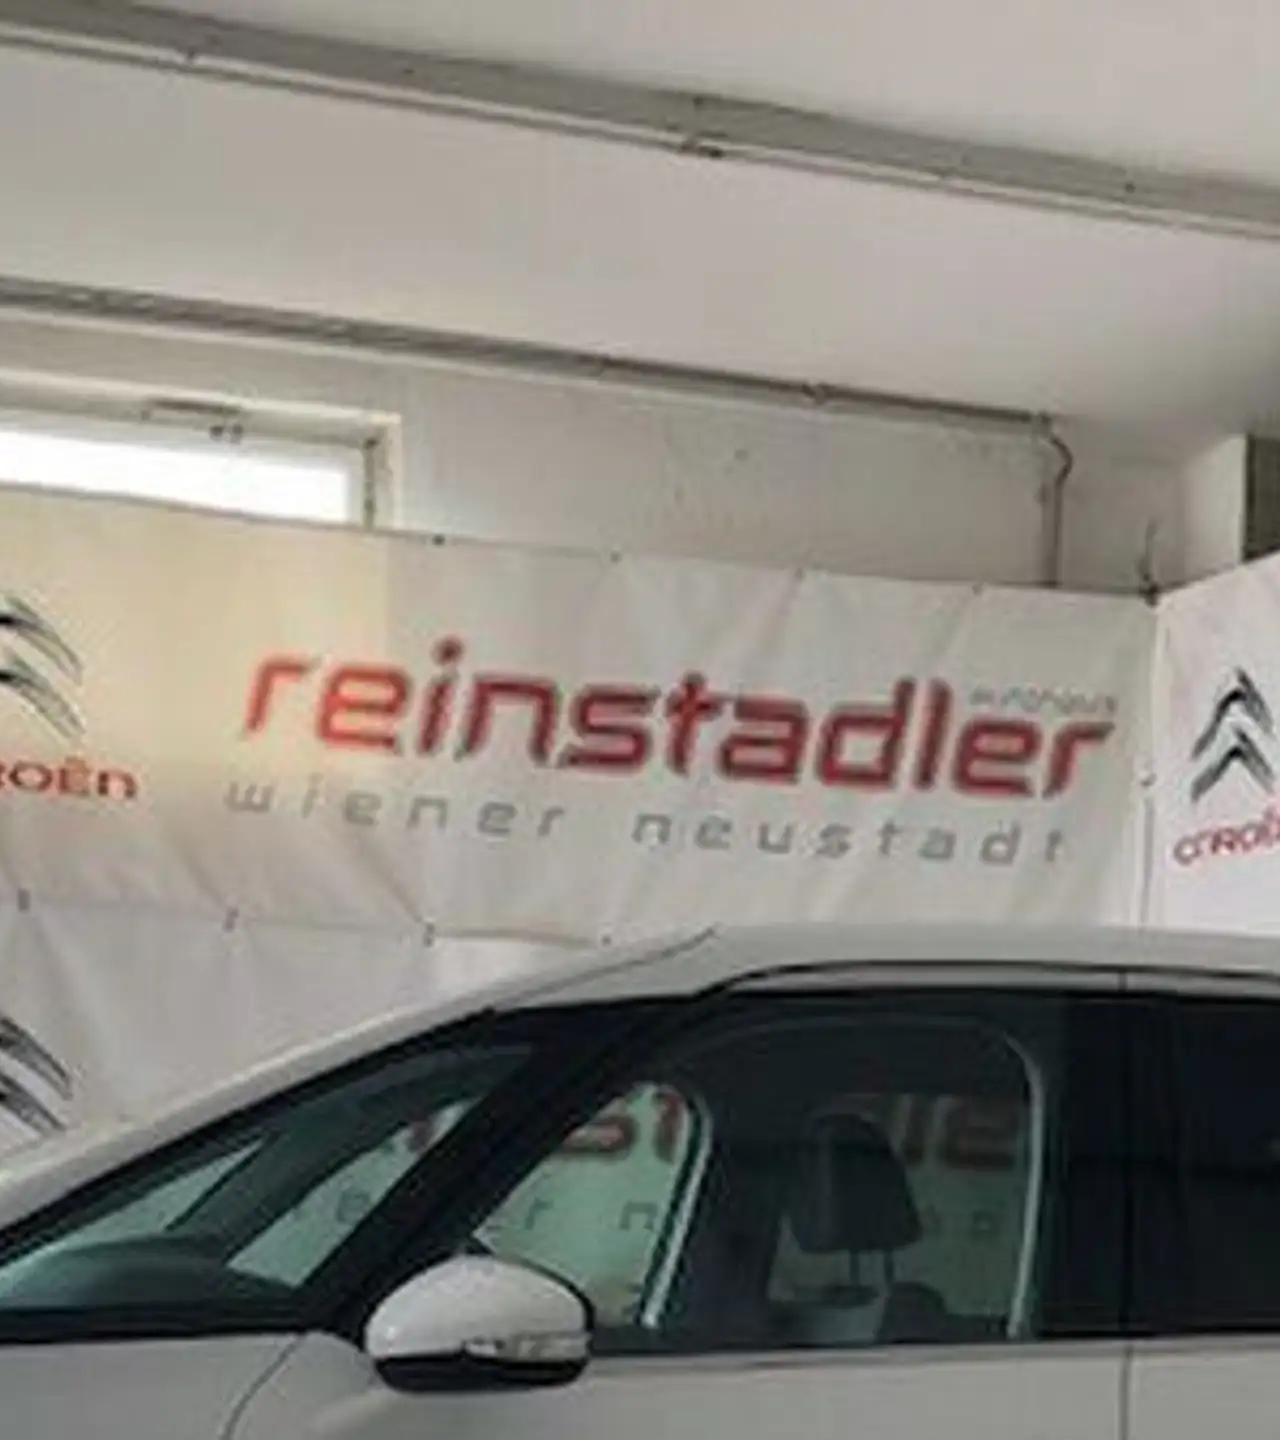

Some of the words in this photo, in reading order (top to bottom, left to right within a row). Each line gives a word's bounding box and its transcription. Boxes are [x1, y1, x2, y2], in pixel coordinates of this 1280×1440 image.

[241, 634, 1117, 800] reinstadler
[222, 776, 565, 840] wiener
[631, 807, 1070, 868] neustadt
